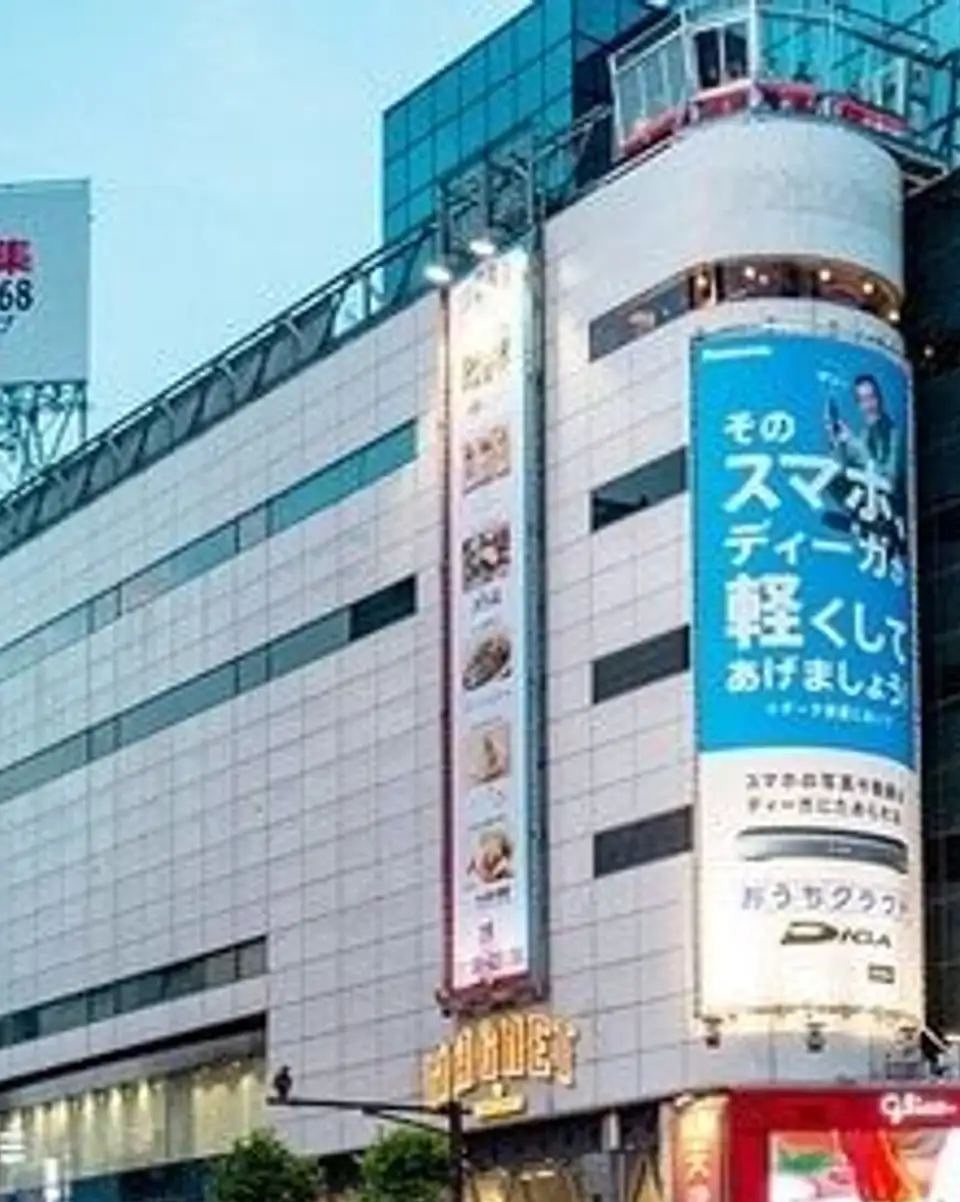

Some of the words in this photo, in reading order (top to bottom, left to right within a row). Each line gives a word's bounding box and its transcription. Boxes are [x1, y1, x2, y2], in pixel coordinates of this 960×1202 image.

[724, 411, 795, 445] その
[723, 454, 894, 522] スマホ
[724, 572, 908, 667] 軽くして
